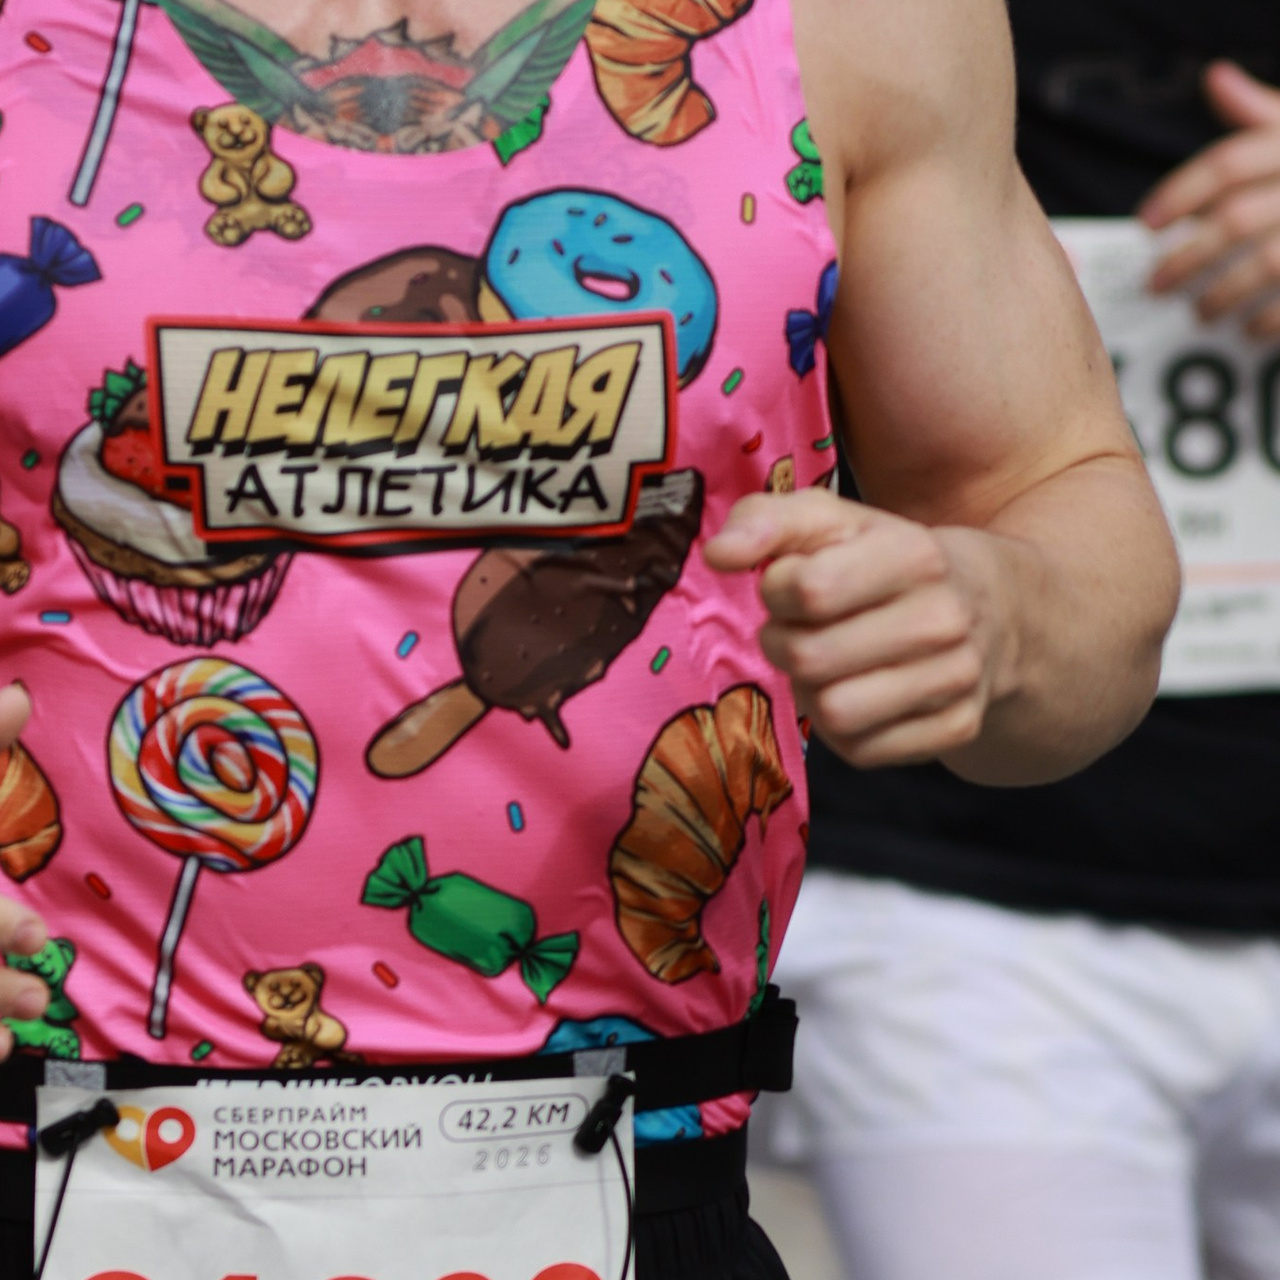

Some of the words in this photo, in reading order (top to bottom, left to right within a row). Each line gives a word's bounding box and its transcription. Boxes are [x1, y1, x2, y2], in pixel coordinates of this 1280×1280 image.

[187, 341, 642, 460] НЕЛЕГКАЯ
[226, 463, 610, 518] АТЛЕТИКА
[213, 1102, 368, 1125] СБЕРПРАЙМ
[458, 1107, 517, 1132] 42,2
[527, 1103, 570, 1126] КМ
[213, 1122, 423, 1152] МОСКОВСКИЙ
[213, 1156, 368, 1178] МАРАФОН
[472, 1144, 551, 1172] 2026
